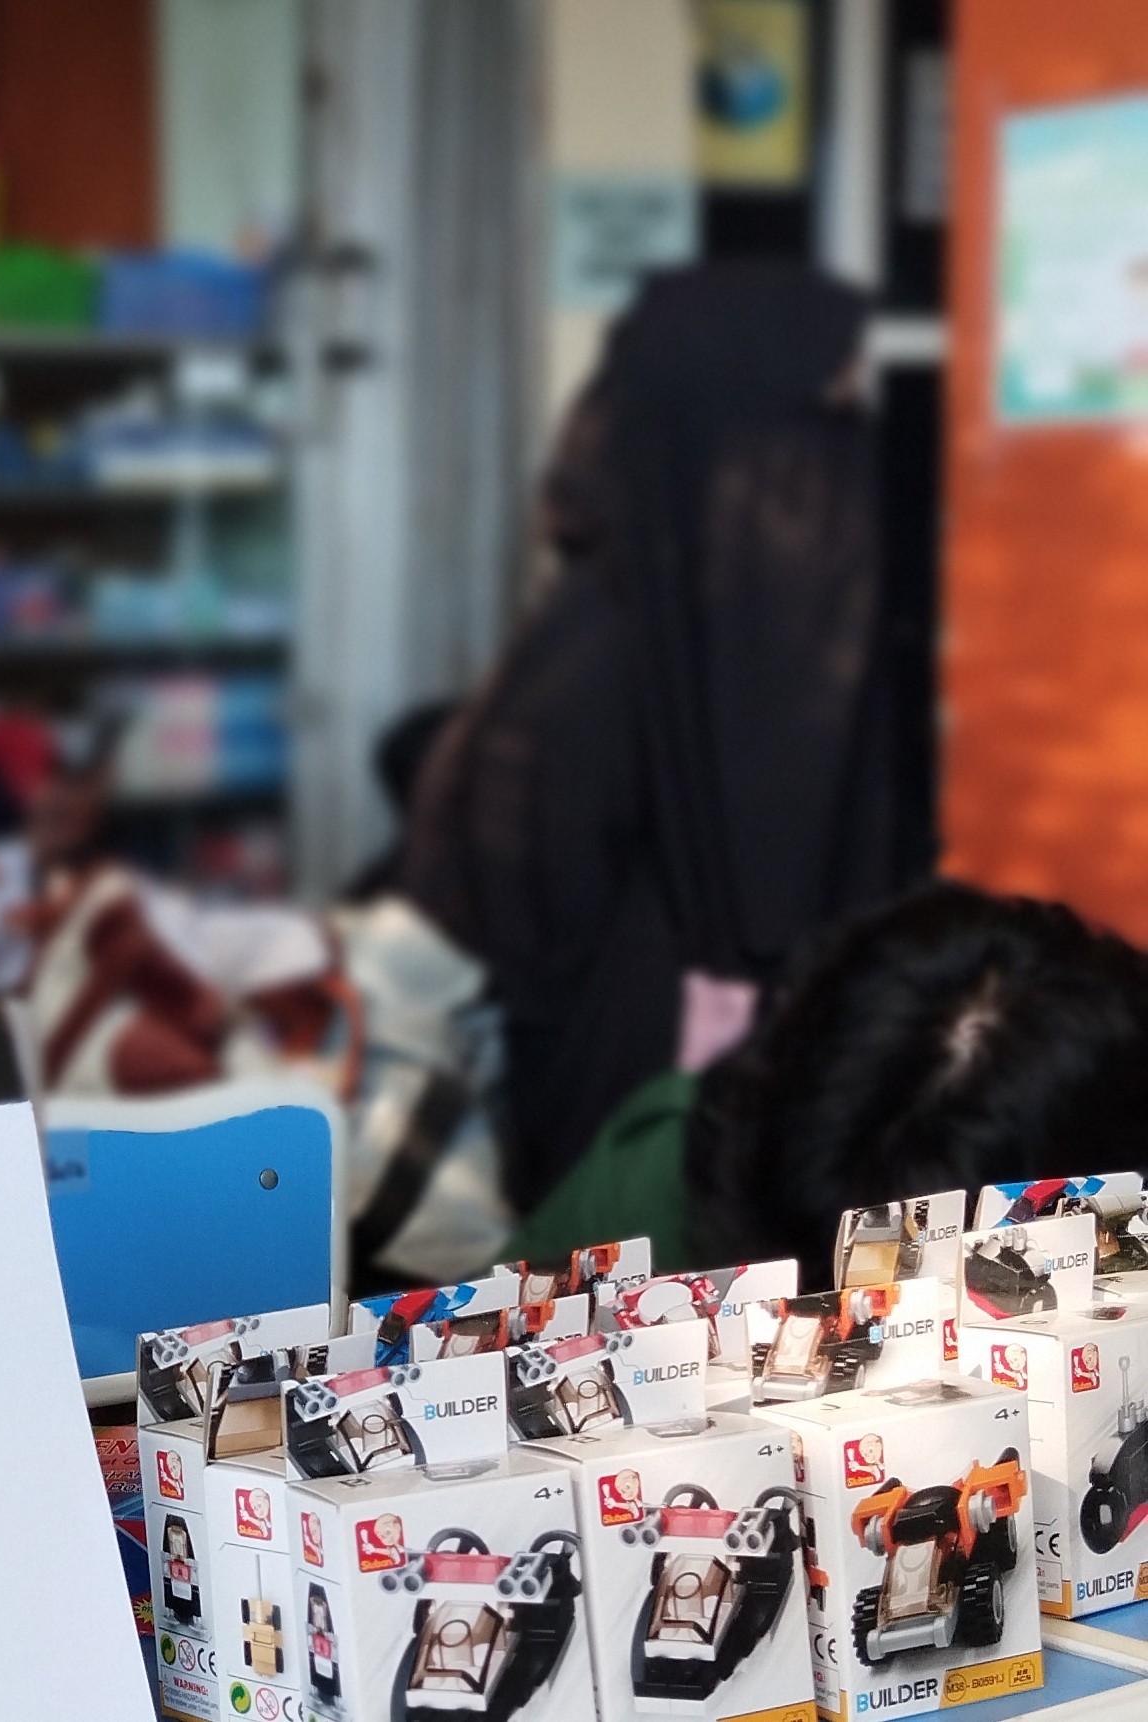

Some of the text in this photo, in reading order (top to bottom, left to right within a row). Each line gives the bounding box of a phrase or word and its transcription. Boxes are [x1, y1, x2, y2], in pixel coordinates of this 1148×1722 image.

[1044, 1252, 1089, 1274] BUILDER
[869, 1318, 935, 1344] BUILDER
[633, 1362, 700, 1386] BUILDER
[423, 1395, 499, 1421] BUILDER
[993, 1407, 1021, 1421] 4+
[757, 1444, 785, 1457] 4+
[534, 1486, 565, 1500] 4+
[1076, 1570, 1135, 1601] BUILDER
[856, 1677, 939, 1713] BUILDER
